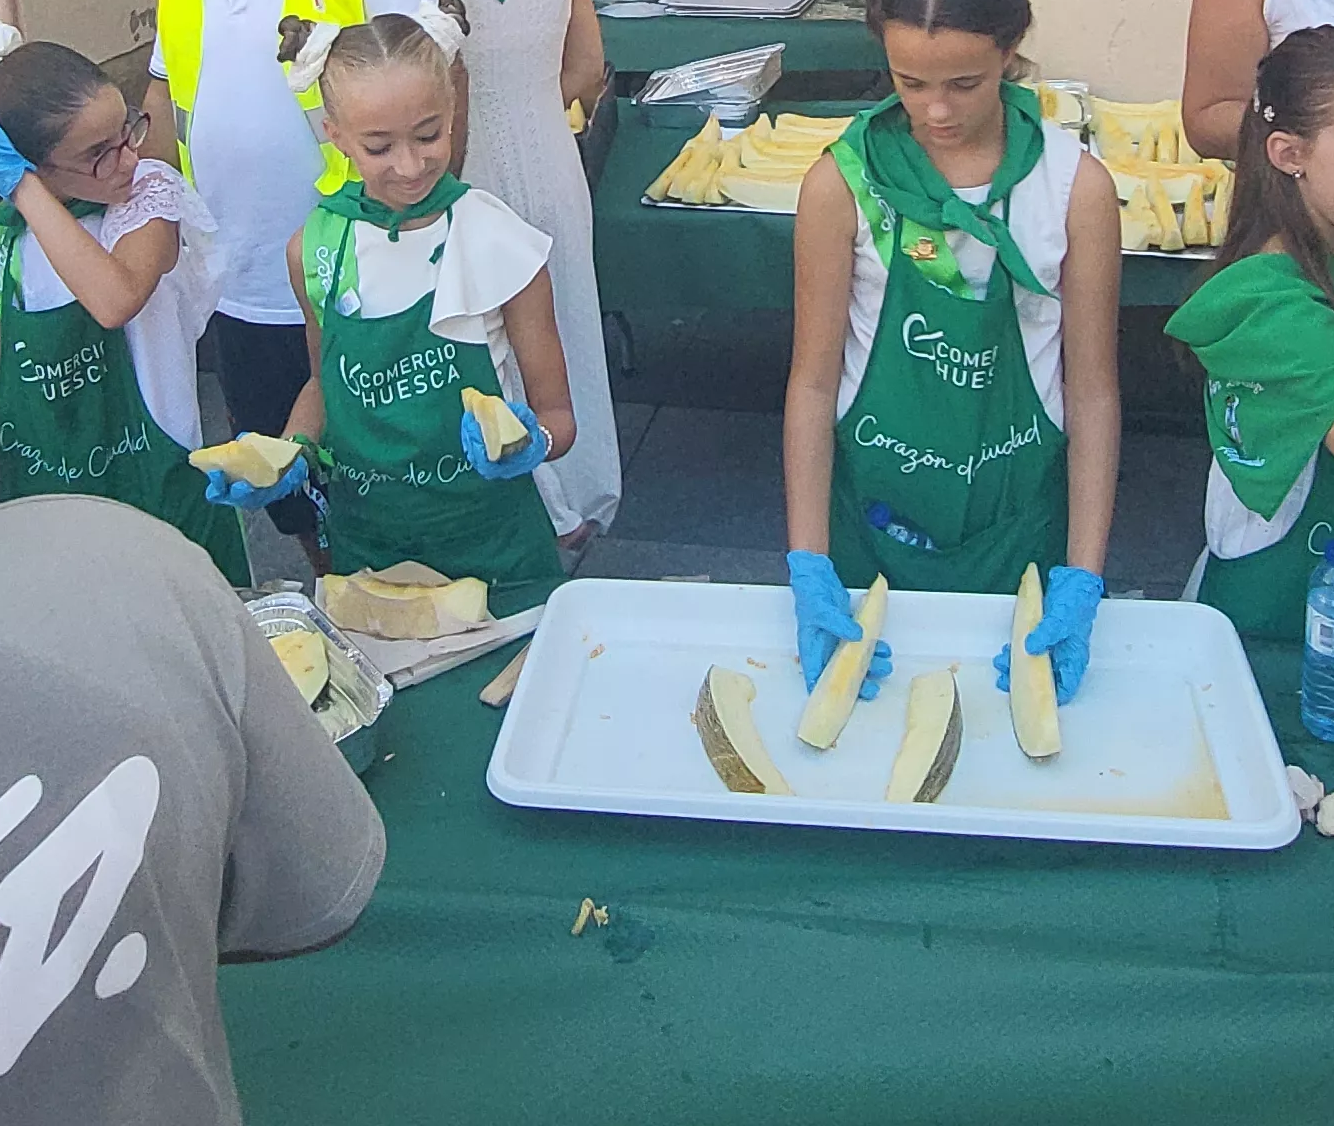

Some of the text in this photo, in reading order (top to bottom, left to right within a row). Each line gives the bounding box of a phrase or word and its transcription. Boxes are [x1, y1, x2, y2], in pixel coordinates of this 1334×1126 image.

[359, 343, 456, 389] COMERCIO
[361, 363, 460, 409] HUESCA
[854, 415, 953, 474] Corazón
[402, 462, 432, 487] de
